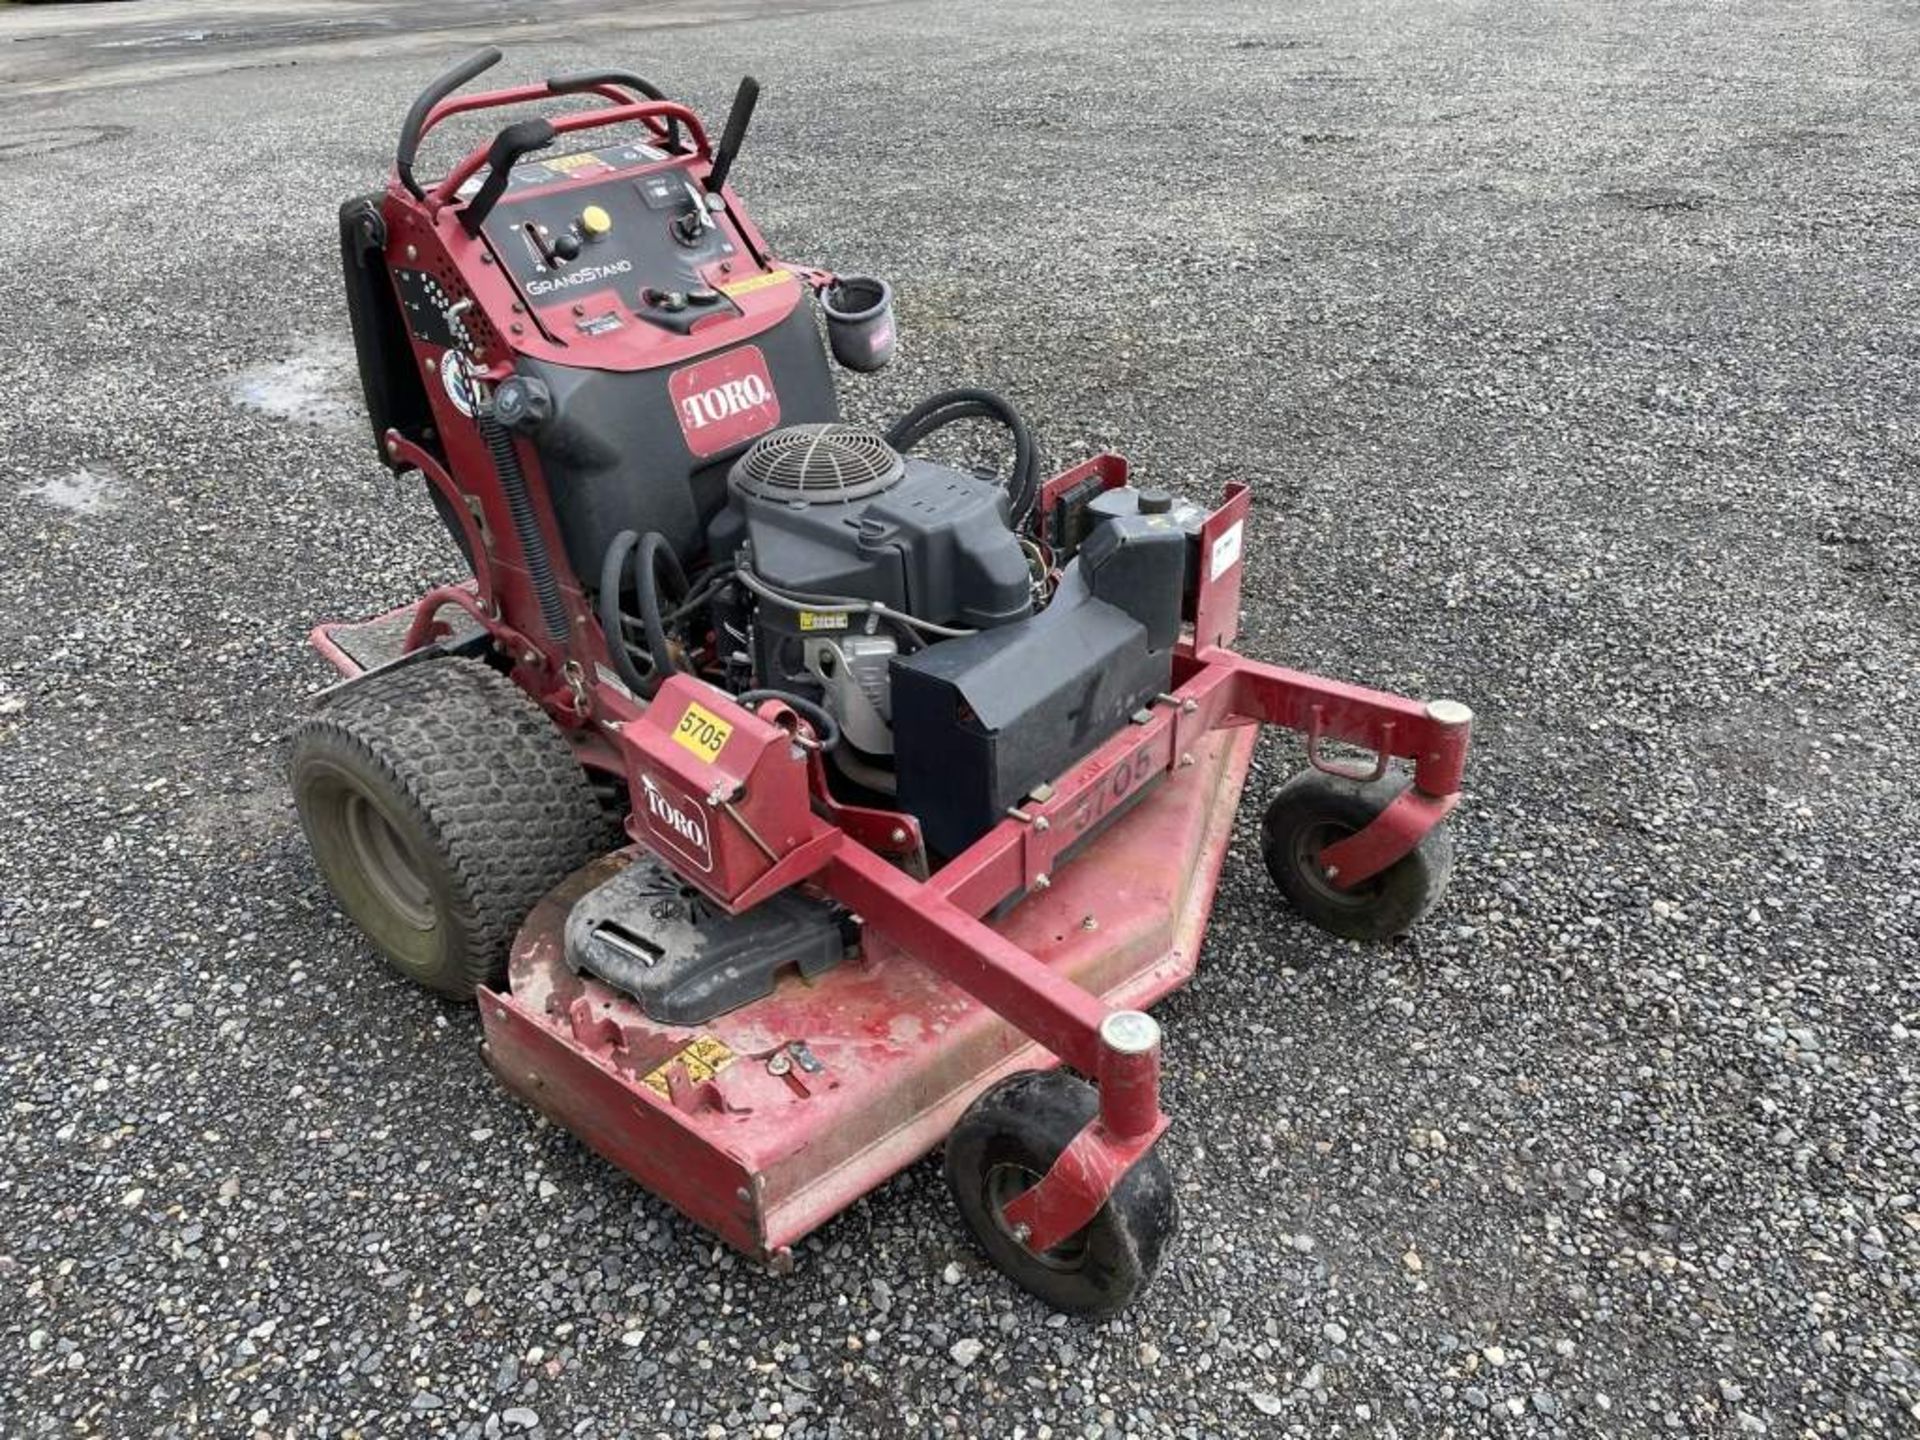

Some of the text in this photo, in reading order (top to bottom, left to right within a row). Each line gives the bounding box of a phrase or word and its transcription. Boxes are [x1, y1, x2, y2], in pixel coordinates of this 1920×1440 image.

[682, 374, 767, 428] TORO
[680, 711, 726, 751] 5705
[642, 774, 704, 847] TORO
